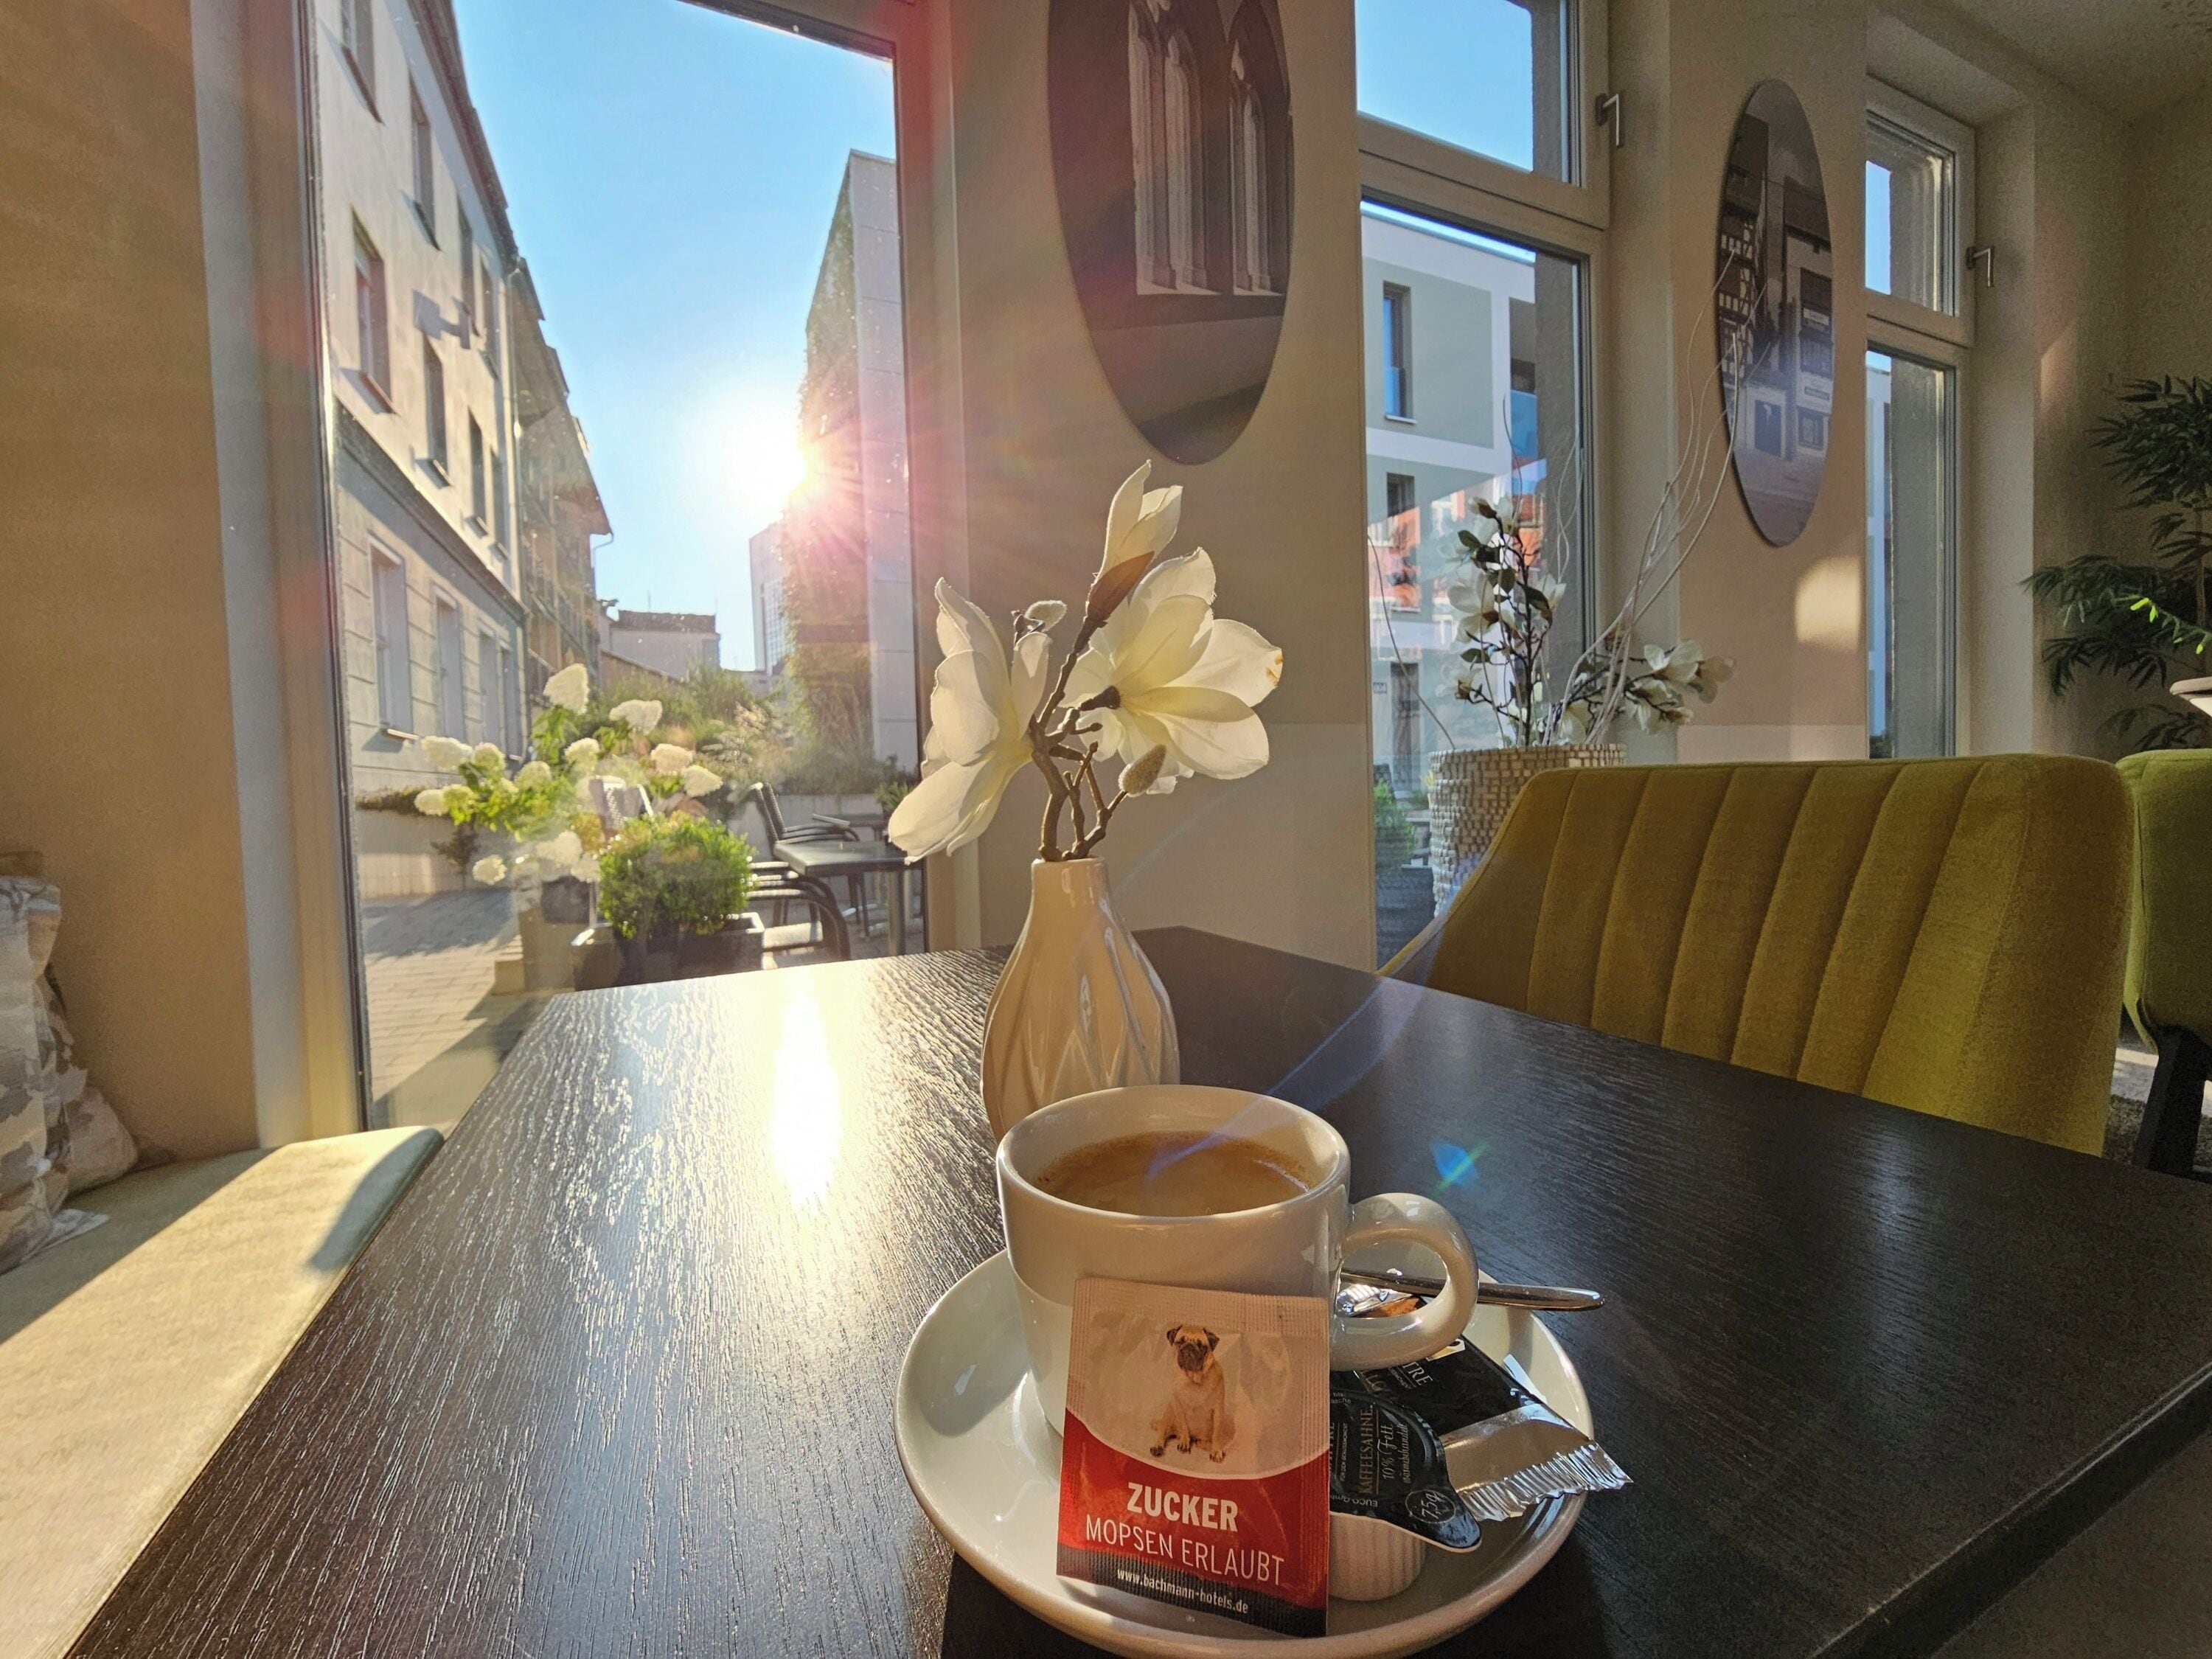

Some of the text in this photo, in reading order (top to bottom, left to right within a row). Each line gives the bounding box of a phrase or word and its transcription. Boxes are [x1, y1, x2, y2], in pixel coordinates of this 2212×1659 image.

[1377, 1424, 1397, 1480] 10% Fett
[1127, 1482, 1239, 1532] ZUCKER
[1352, 1499, 1378, 1507] EUCO
[1086, 1514, 1285, 1585] MOPSEN ERLAUBT
[1117, 1568, 1249, 1615] www.bachmann-hotels.de
